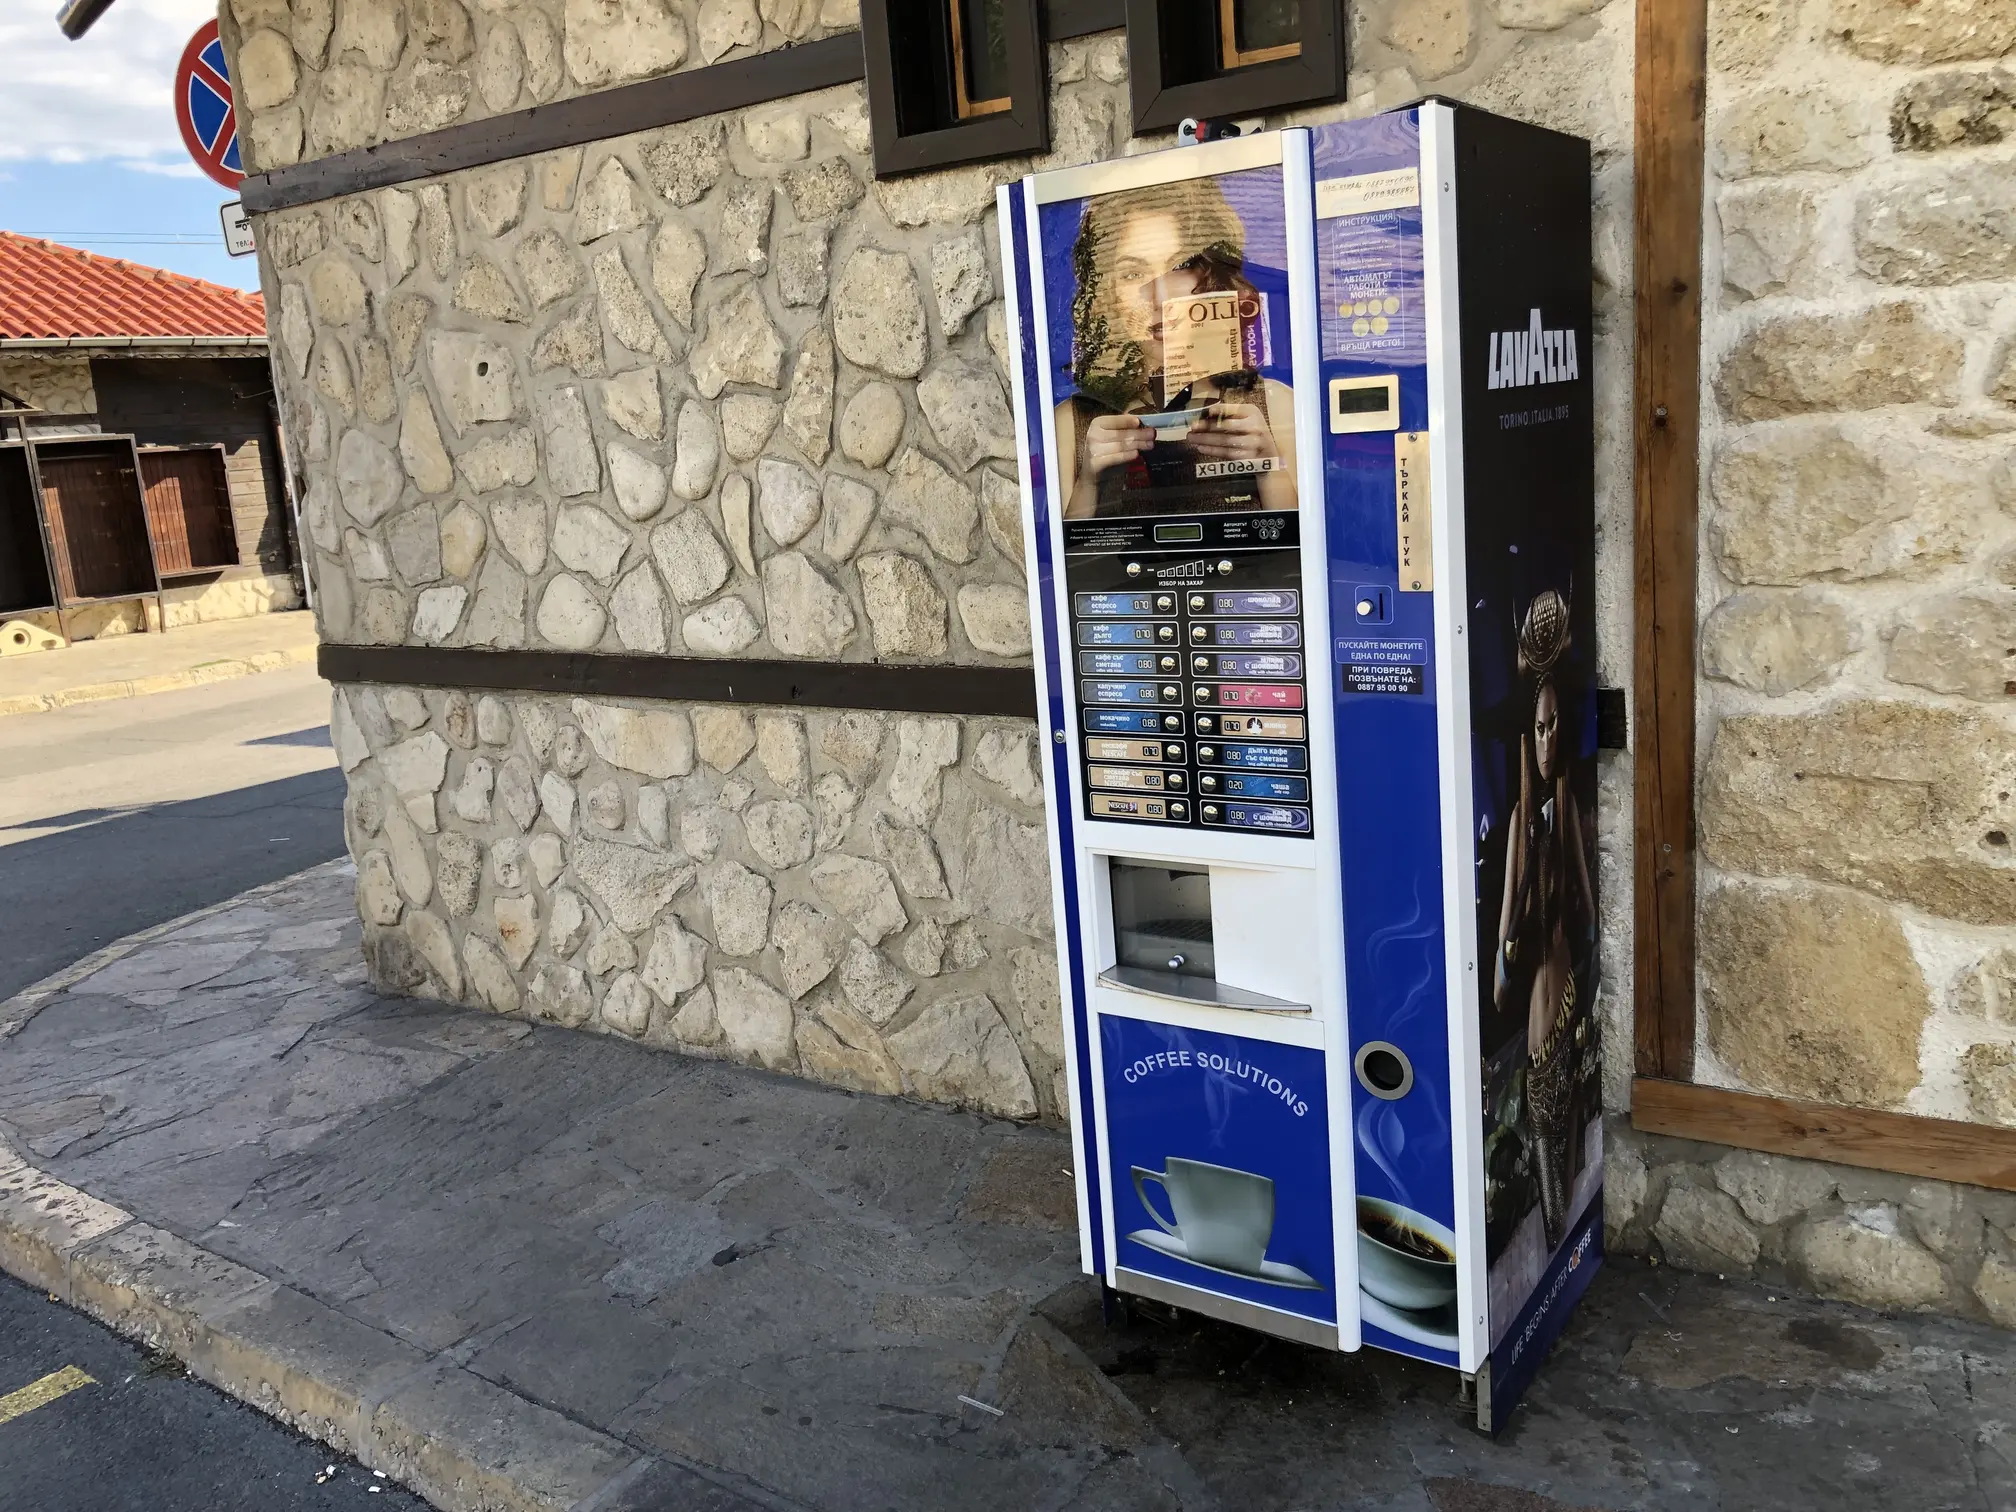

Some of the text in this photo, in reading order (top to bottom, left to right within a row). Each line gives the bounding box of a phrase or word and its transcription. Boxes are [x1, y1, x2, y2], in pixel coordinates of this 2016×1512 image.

[1339, 212, 1393, 227] ИНСТРУКЦИЯ
[1344, 271, 1393, 284] АВТОМАТЪТ
[1349, 281, 1380, 291] РАБОТИ
[1350, 288, 1388, 299] МОНЕТИ:
[1341, 341, 1371, 352] ВРЪЩА
[1488, 308, 1578, 390] LAVAZZA
[1400, 458, 1409, 523] ТЪРКАЙ
[1093, 624, 1109, 633] кафе
[1339, 641, 1423, 650] ПУСКАЙТЕ МОНЕТИТЕ
[1095, 653, 1112, 661] кафе
[1351, 652, 1372, 660] ЕДНА
[1387, 653, 1411, 661] ЕДНА!
[1371, 667, 1412, 675] ПОВРЕДА
[1348, 675, 1416, 684] ПОЗВЪНАТЕ НА:
[1097, 683, 1127, 691] капучино
[1226, 751, 1241, 760] 0.80
[1269, 748, 1287, 756] кафе
[1228, 781, 1243, 789] 0.20
[1231, 811, 1245, 820] 0.80
[1124, 1051, 1308, 1117] COFFEE SOLUTIONS
